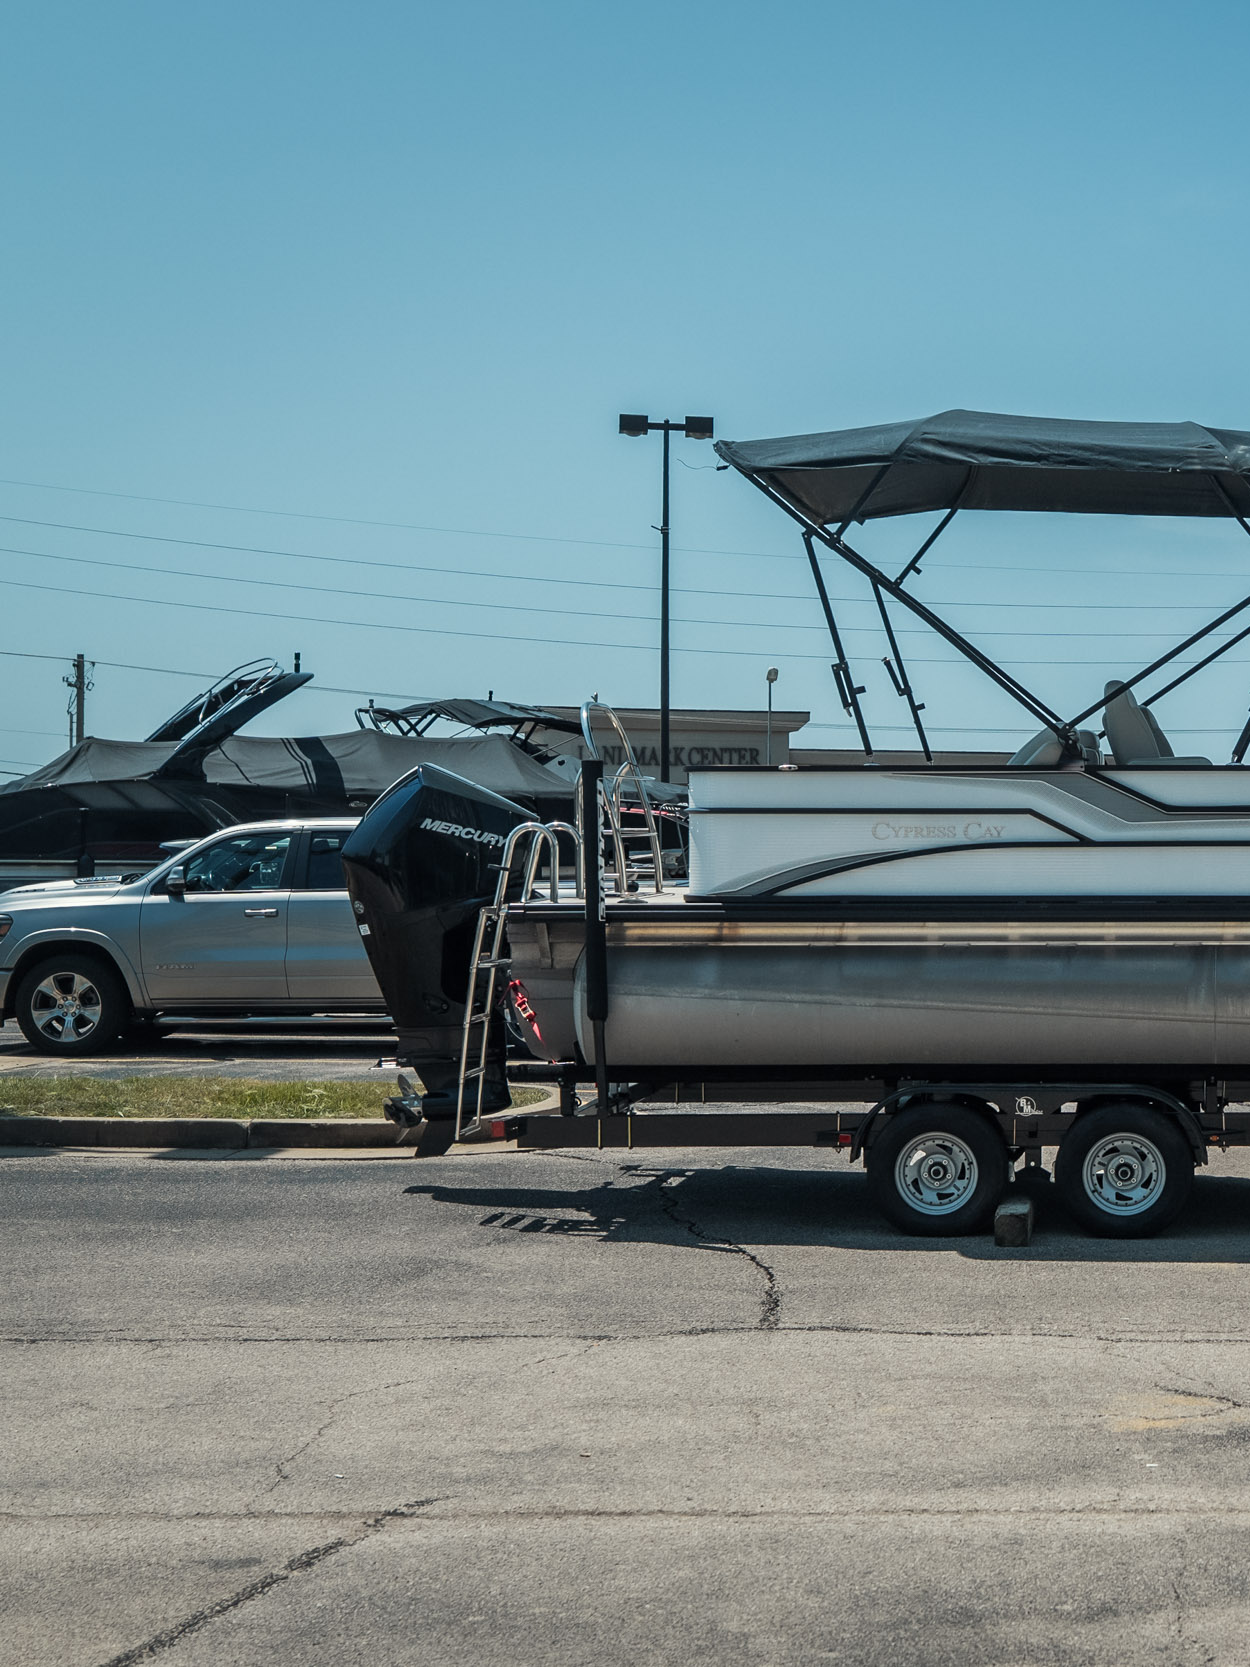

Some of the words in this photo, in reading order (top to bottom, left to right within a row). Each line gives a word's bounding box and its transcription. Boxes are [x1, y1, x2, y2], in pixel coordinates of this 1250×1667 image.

[687, 747, 761, 766] CENTER
[420, 818, 507, 847] MERCURY
[871, 822, 957, 840] CYPRESS
[963, 822, 1006, 840] CAY
